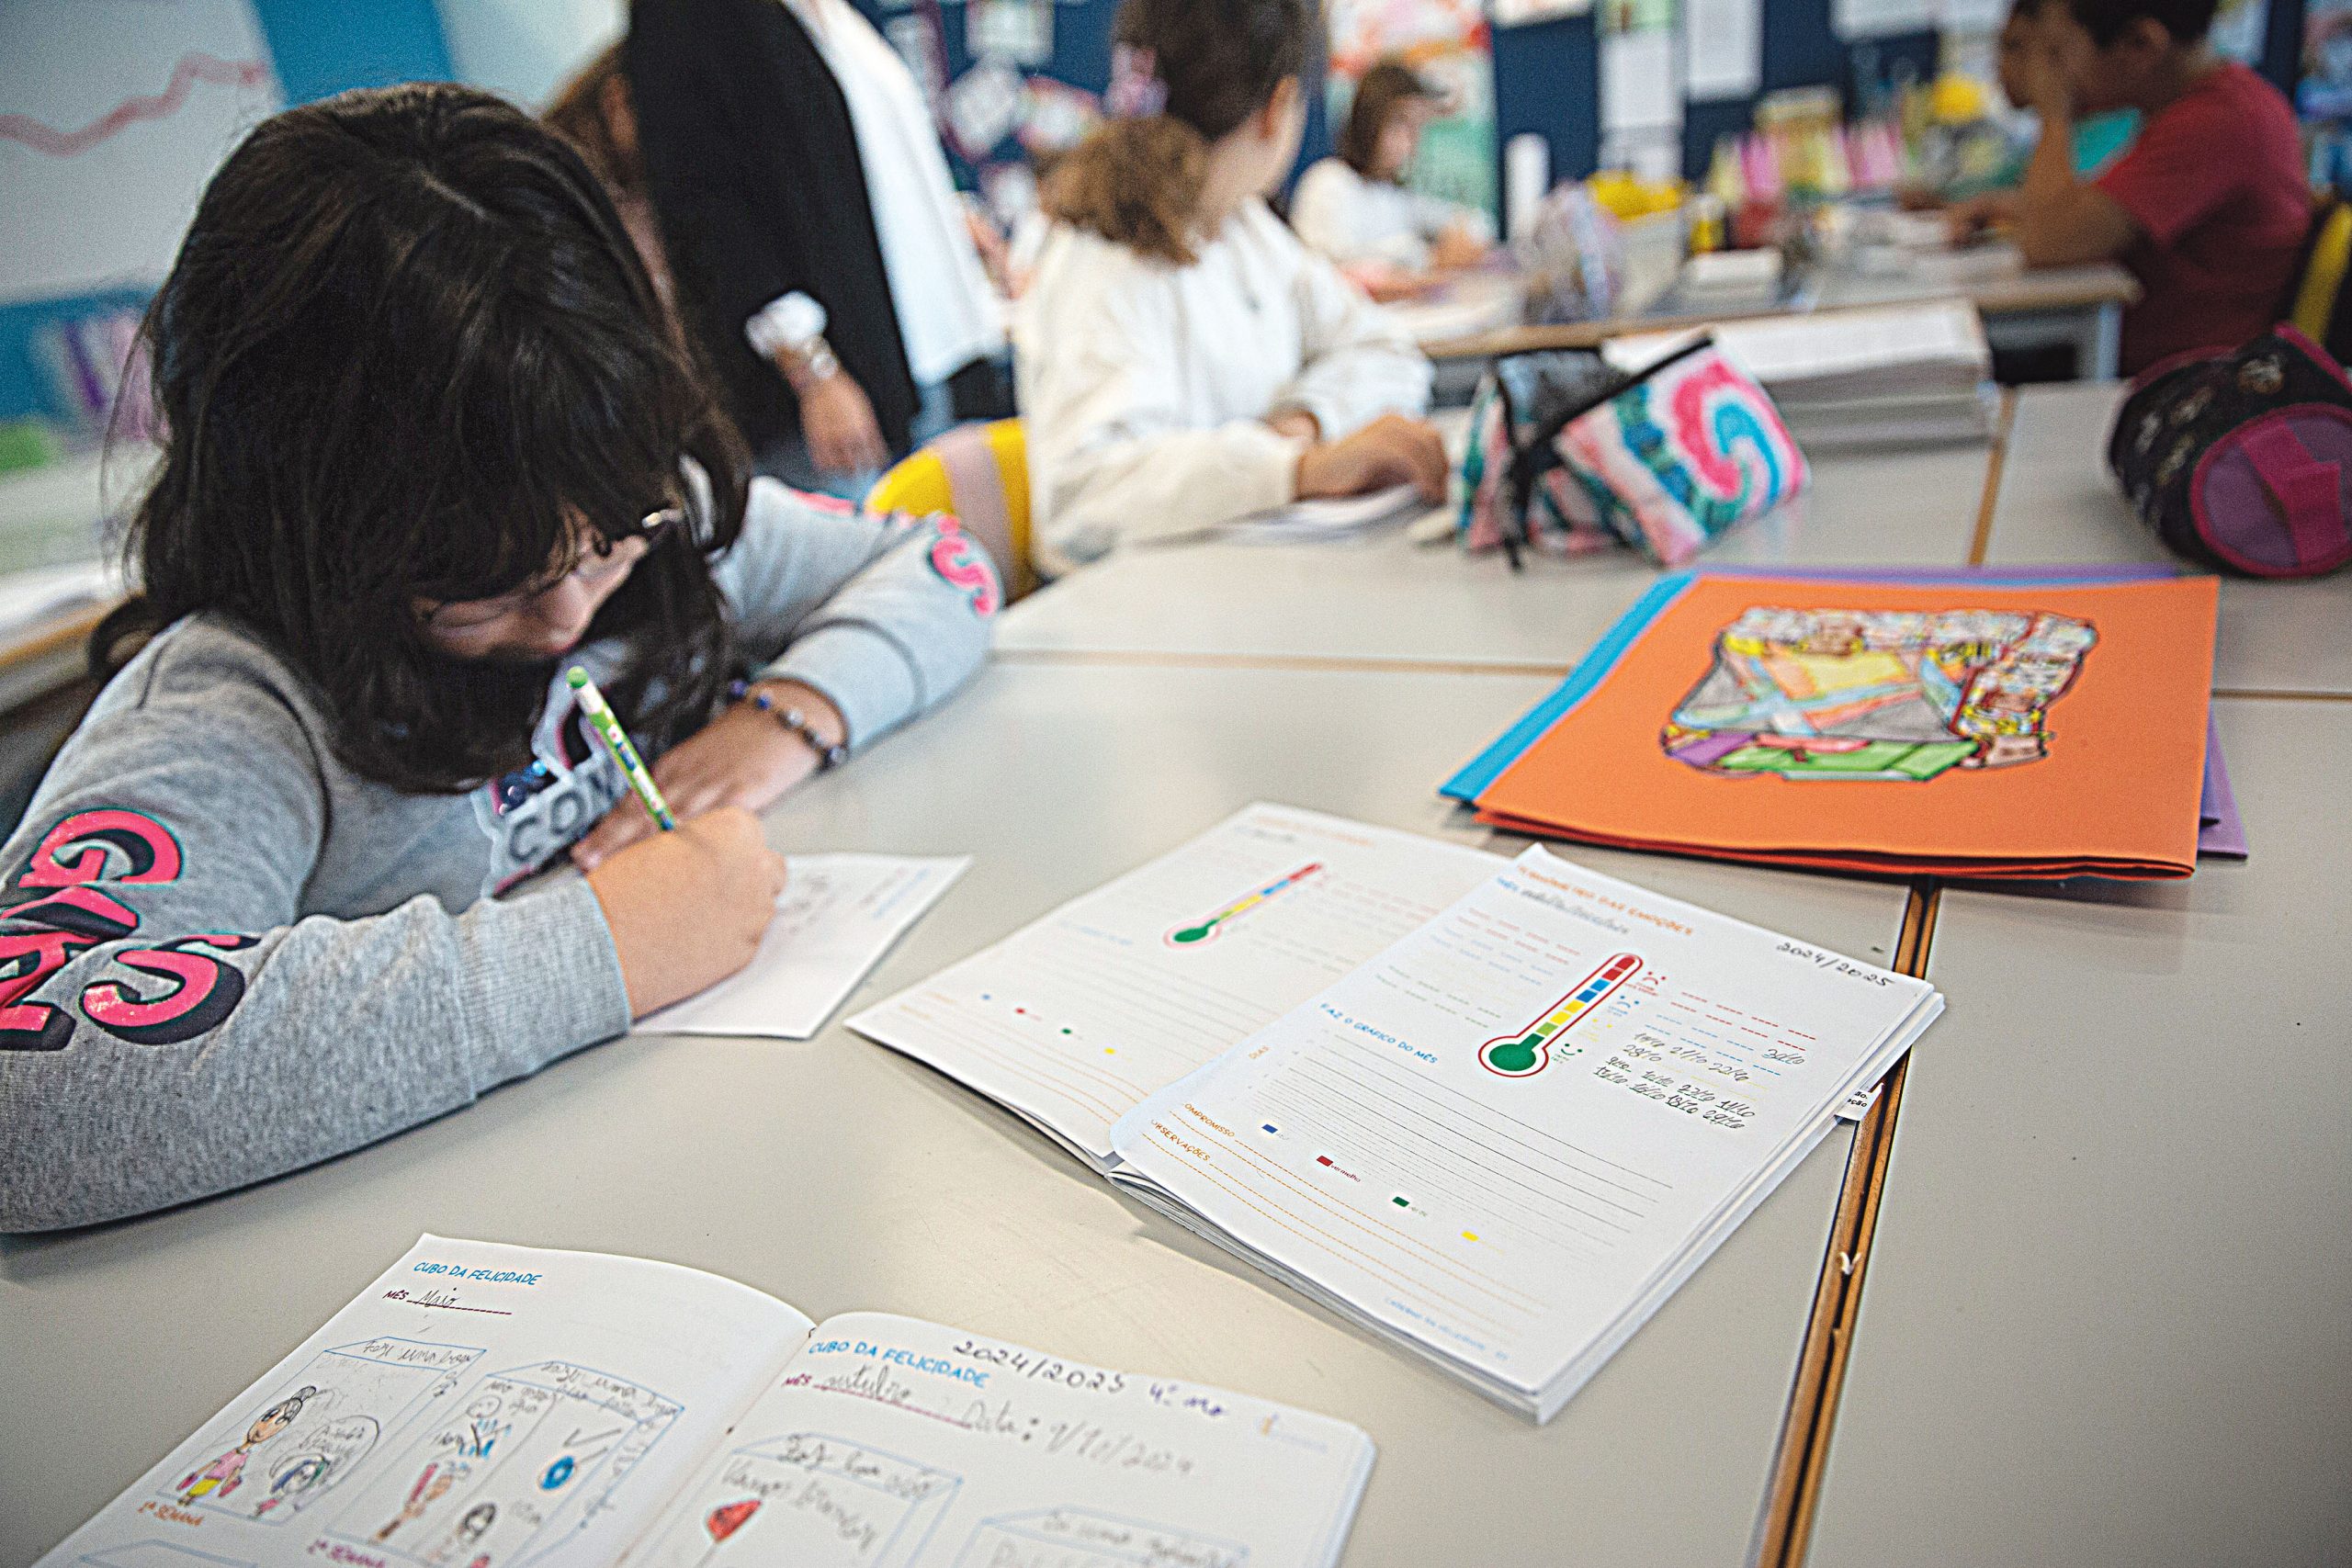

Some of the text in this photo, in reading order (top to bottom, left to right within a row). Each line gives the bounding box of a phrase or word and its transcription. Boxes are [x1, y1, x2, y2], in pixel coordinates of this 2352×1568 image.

[1777, 942, 1894, 986] 2024/2025
[1320, 1002, 1342, 1020] FAZ
[1397, 1041, 1413, 1052] DO
[1414, 1049, 1438, 1064] MÊS
[1180, 1102, 1235, 1138] OMPROMISSO
[413, 1261, 543, 1286] CUBO DA FELICIDADE
[382, 1289, 410, 1301] MÊS
[808, 1340, 990, 1389] CUBO DA FELICIDADE
